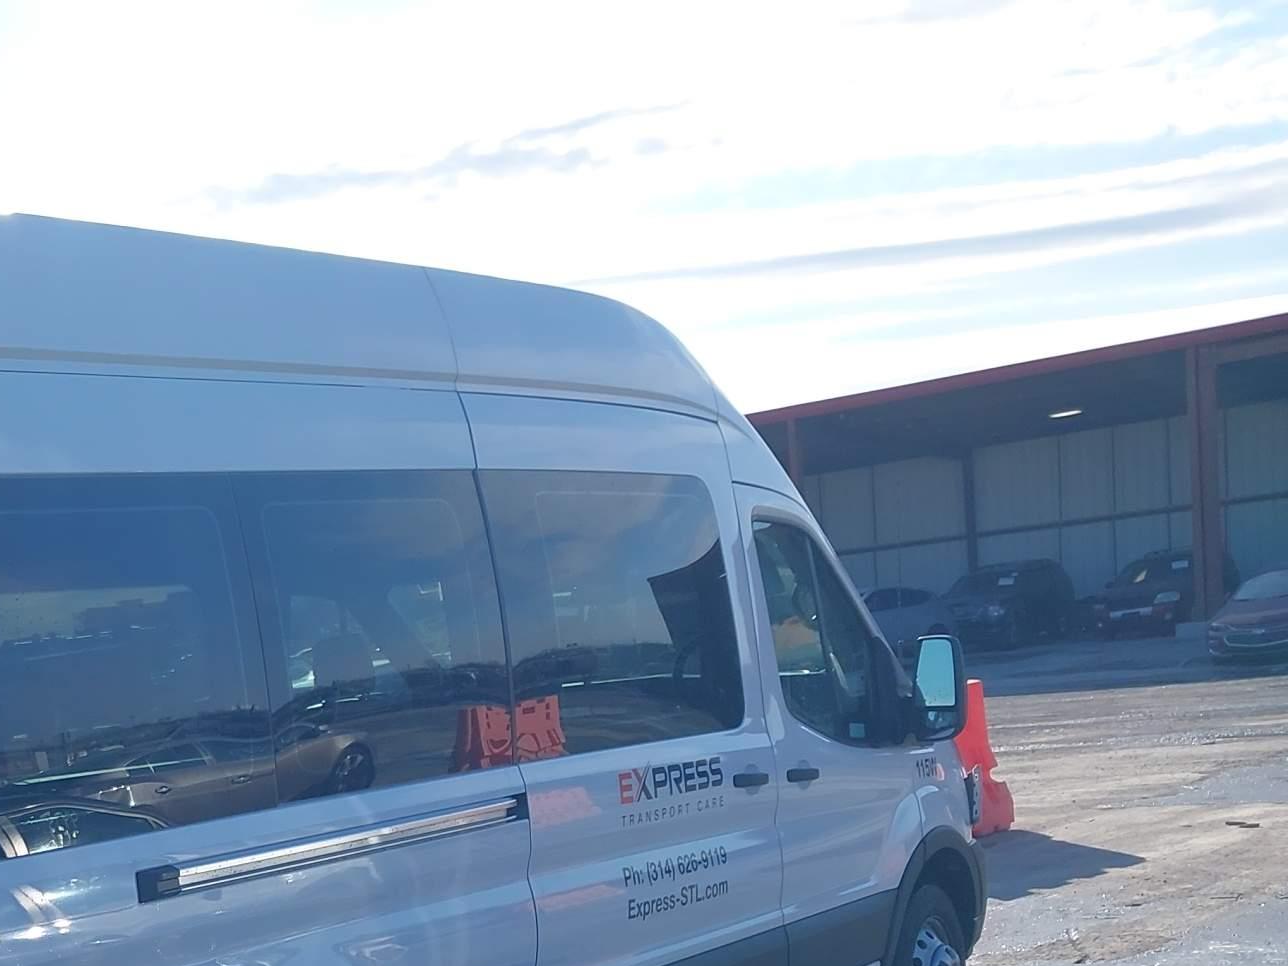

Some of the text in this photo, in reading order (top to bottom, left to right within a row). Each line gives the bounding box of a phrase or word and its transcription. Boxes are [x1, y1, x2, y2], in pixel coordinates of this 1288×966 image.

[618, 757, 723, 804] EXPRESS
[621, 796, 725, 827] TRANSPORT CARE
[623, 846, 727, 887] Ph: (314) 626-9119
[628, 880, 728, 920] Express-STL.com
